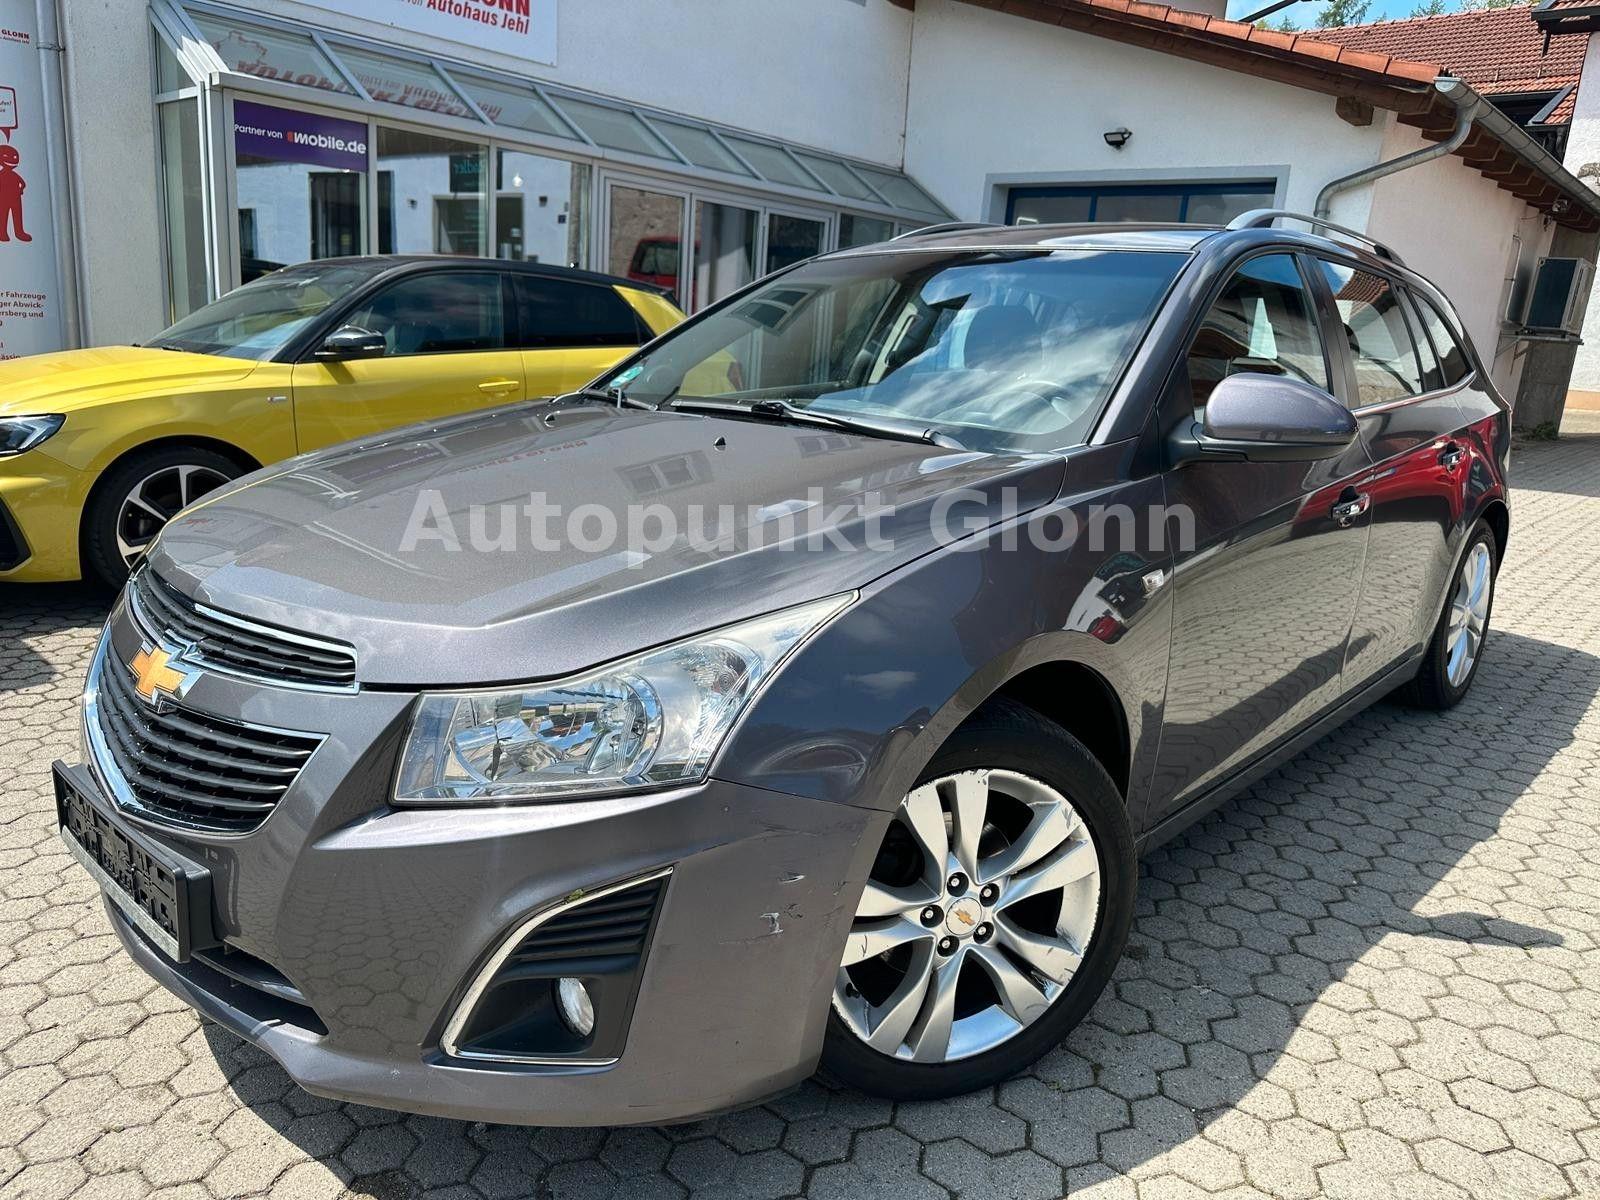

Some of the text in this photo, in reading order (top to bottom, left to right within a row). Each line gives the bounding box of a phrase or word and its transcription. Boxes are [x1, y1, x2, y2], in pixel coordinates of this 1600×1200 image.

[427, 0, 498, 26] Autohaus
[501, 13, 530, 34] Jehl
[1, 29, 29, 39] GLONN
[234, 124, 266, 137] Partner
[267, 130, 283, 139] von
[6, 291, 47, 301] Fahrzeuge
[13, 301, 44, 309] Abwick-
